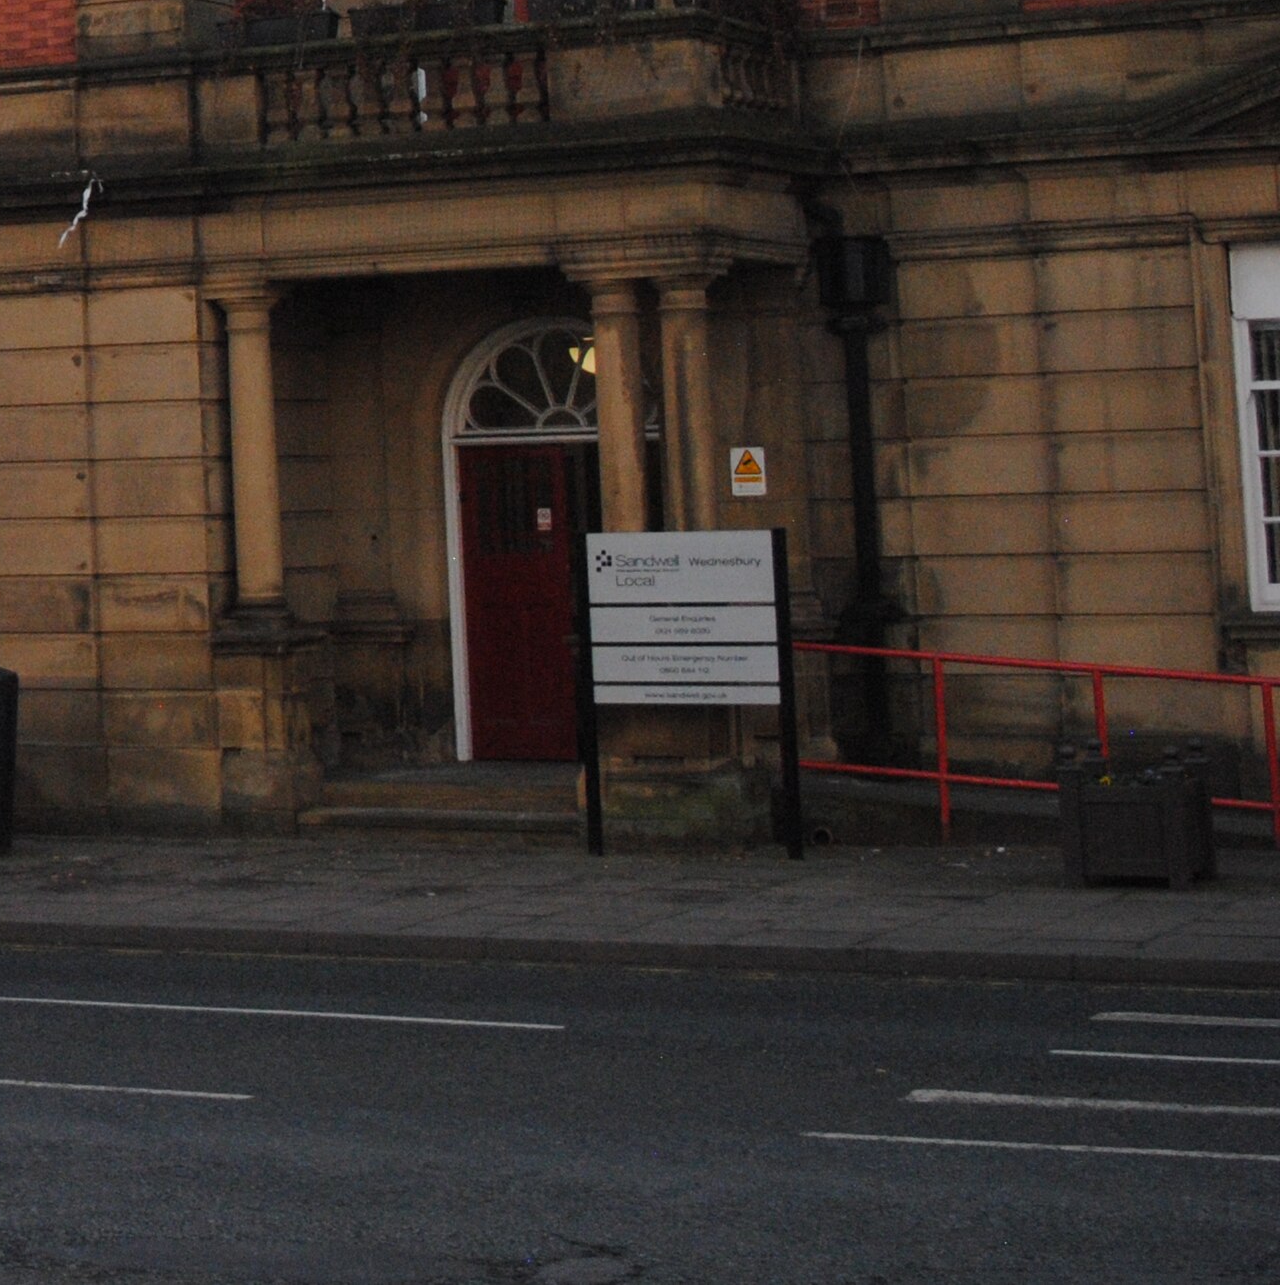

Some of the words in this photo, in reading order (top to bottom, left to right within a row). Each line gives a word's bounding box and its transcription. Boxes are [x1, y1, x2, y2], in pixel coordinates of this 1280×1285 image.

[615, 554, 680, 567] Sandwell
[688, 556, 762, 569] Wednesbury
[615, 575, 656, 587] Local
